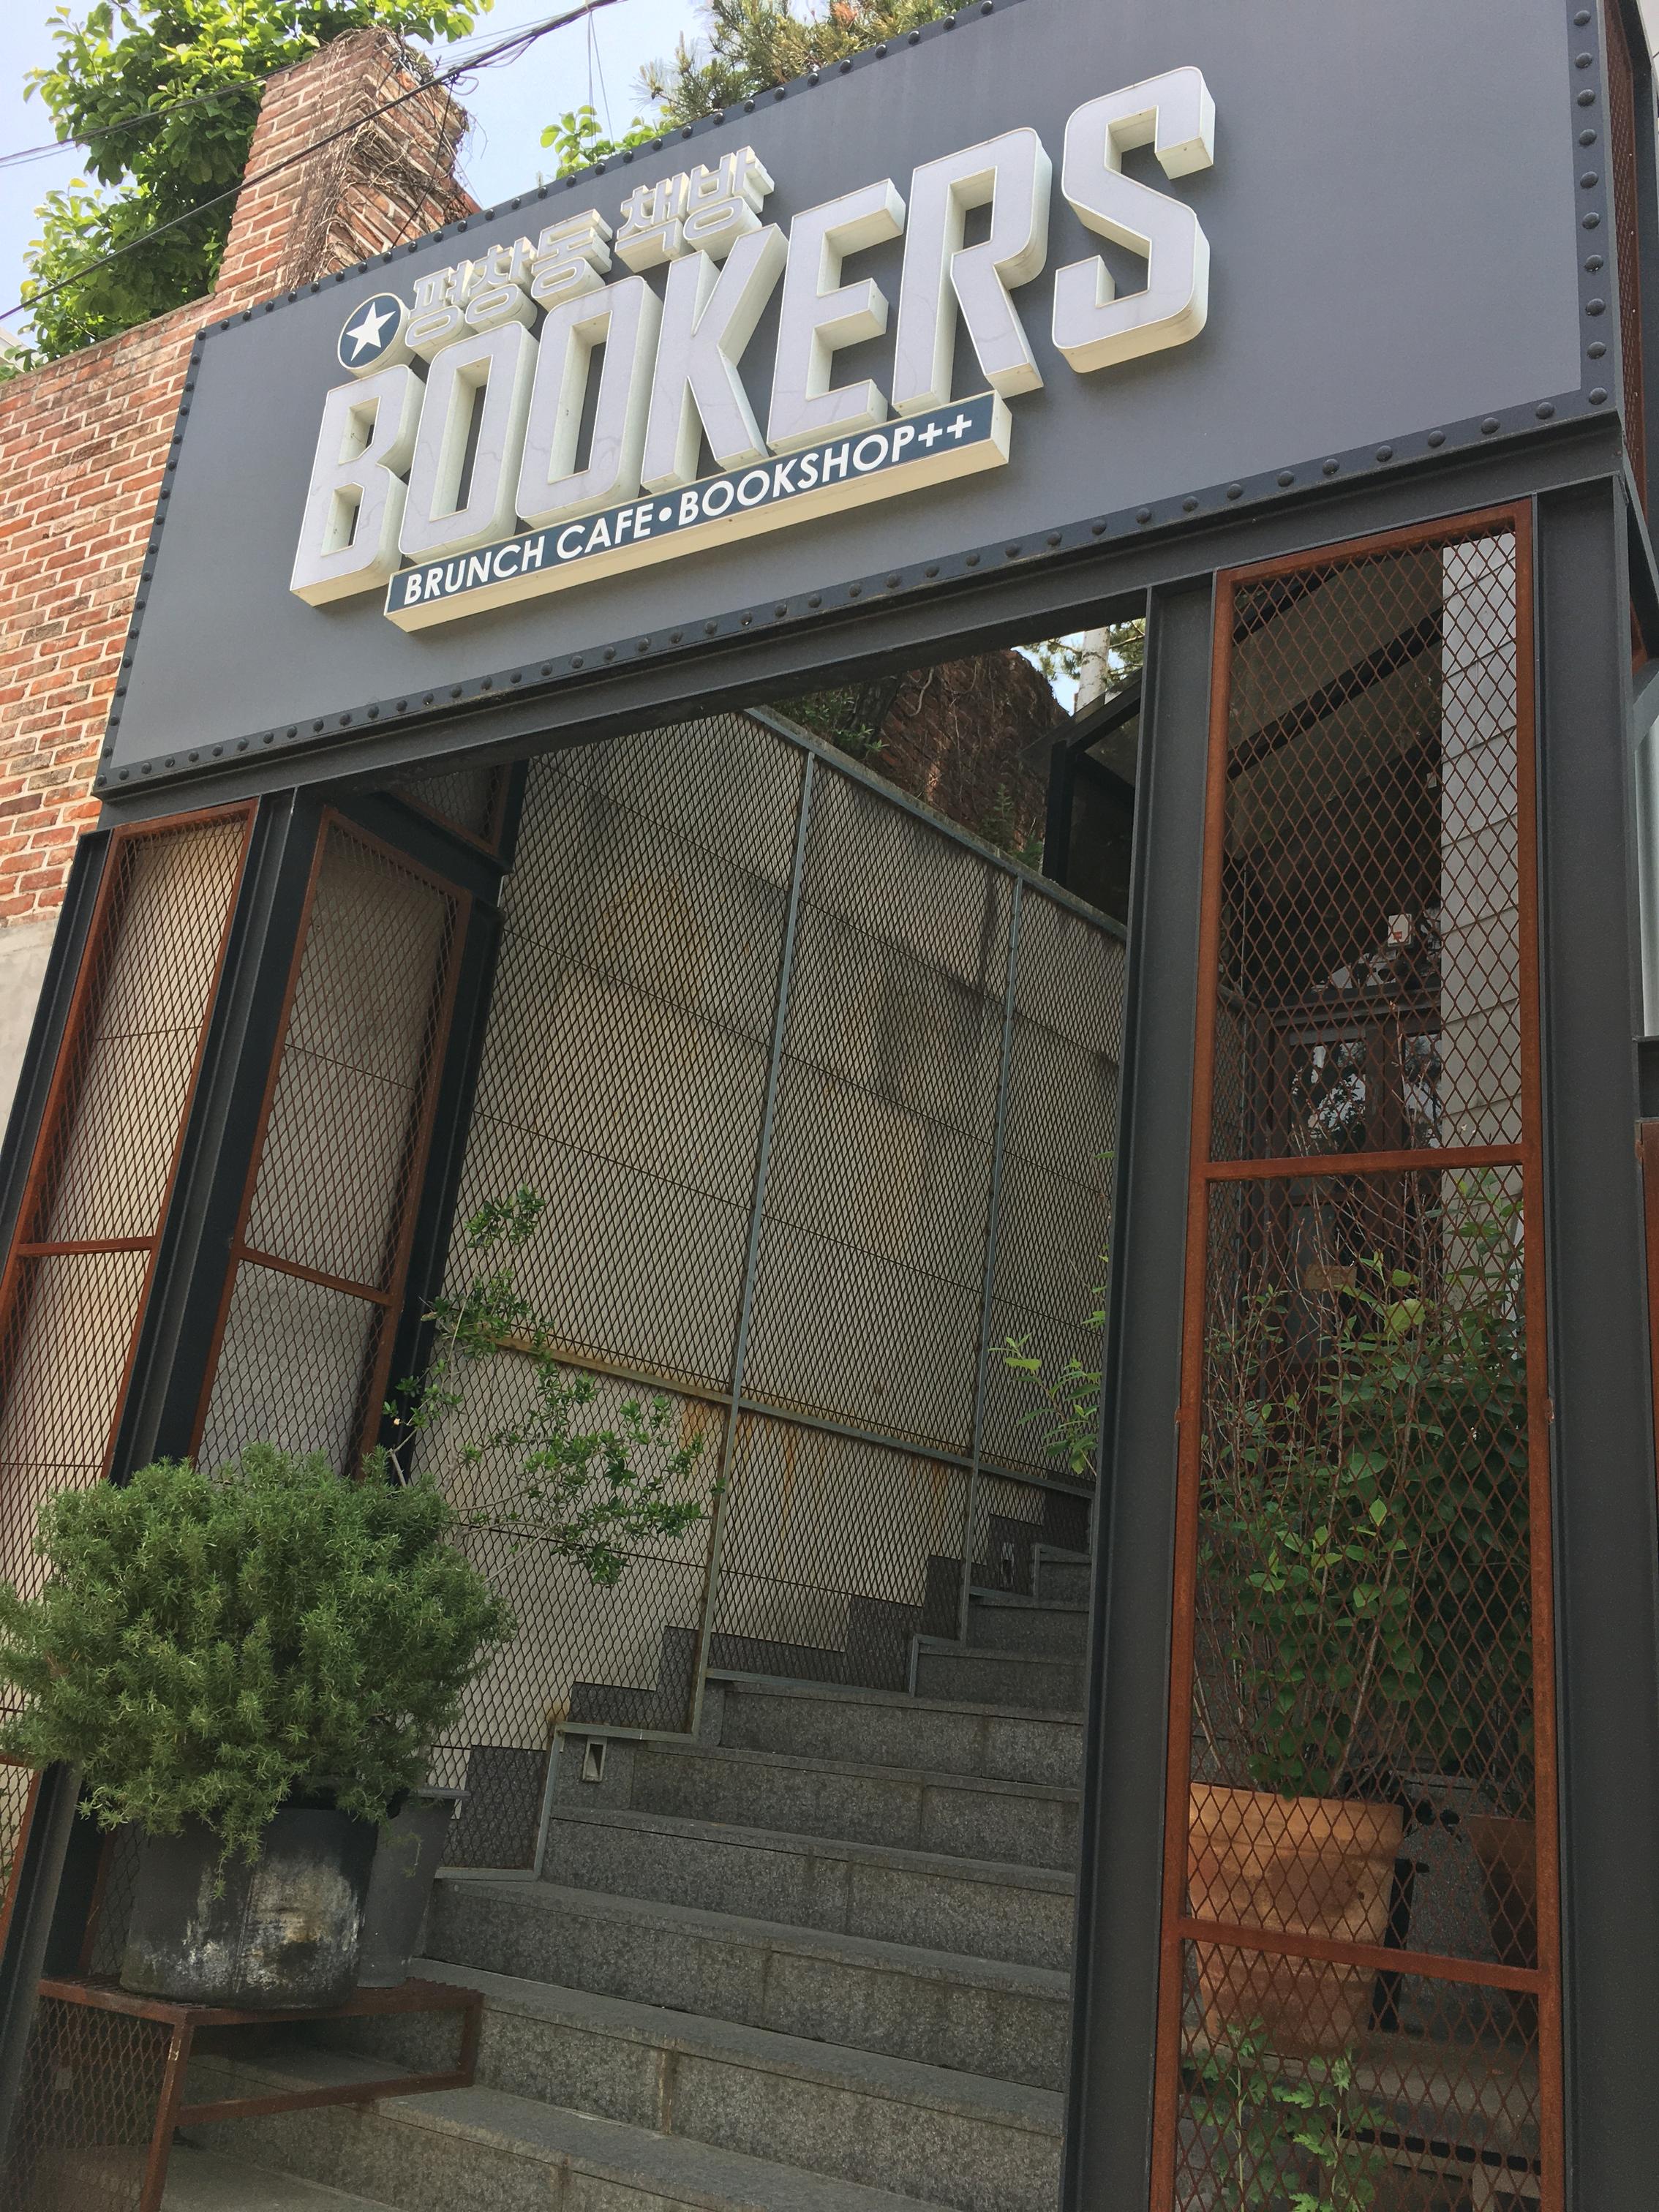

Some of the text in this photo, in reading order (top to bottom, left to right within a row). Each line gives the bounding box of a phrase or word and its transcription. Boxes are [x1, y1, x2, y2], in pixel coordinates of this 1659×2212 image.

[290, 66, 1209, 594] BOOKERS
[405, 146, 762, 347] 평창동 책방
[403, 535, 545, 605] BRUNCH
